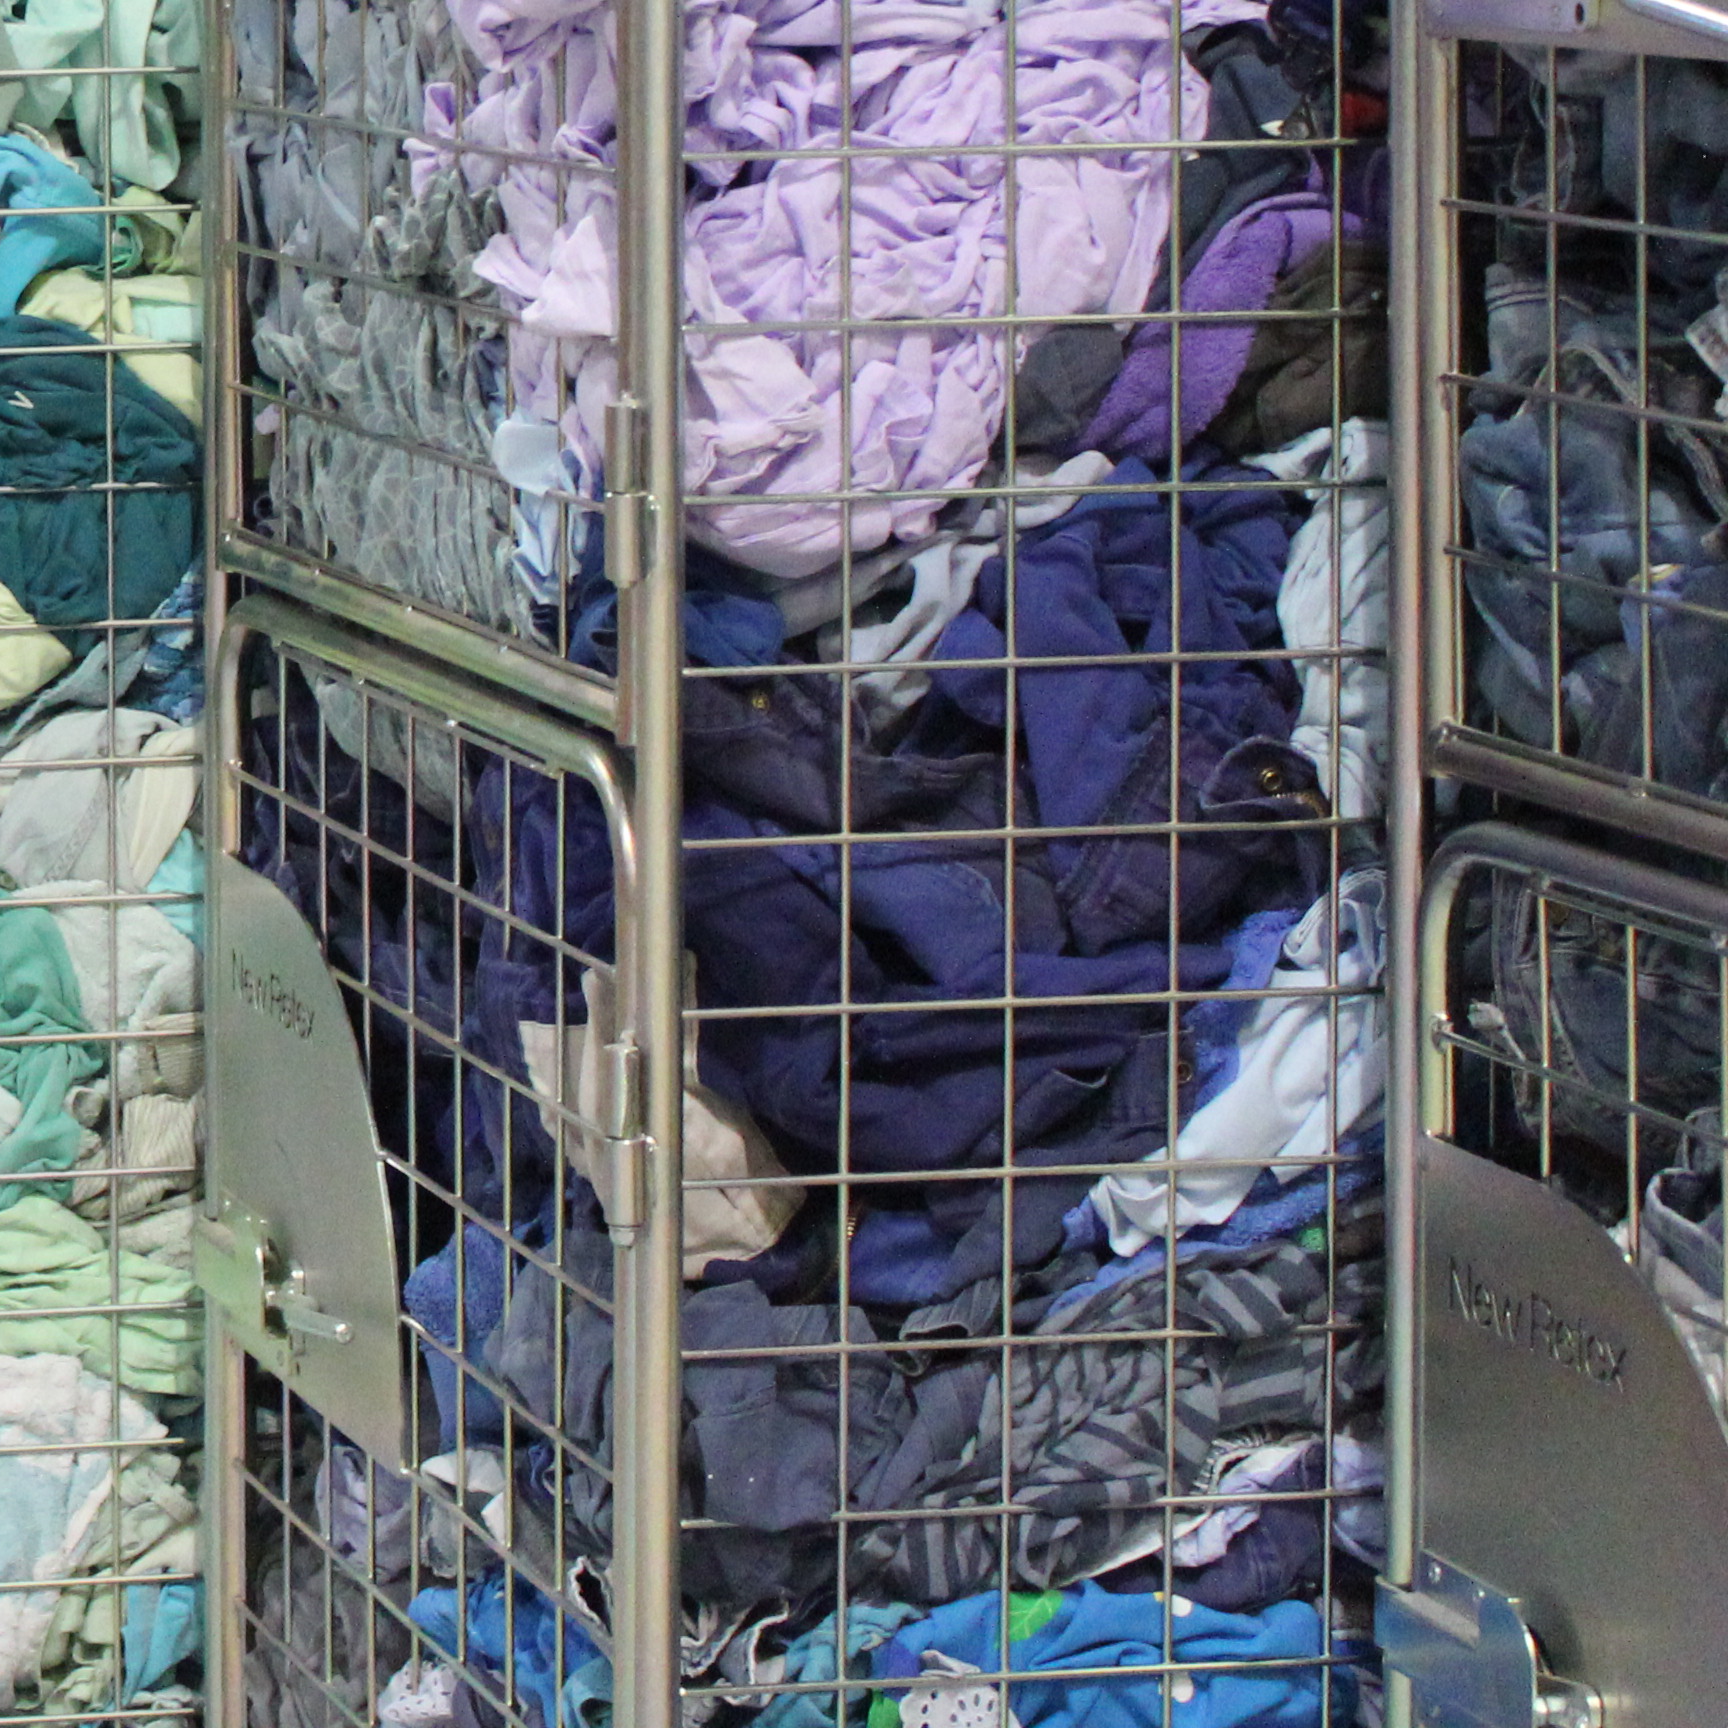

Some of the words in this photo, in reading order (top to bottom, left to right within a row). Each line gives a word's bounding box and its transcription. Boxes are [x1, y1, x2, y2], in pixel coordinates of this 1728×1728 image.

[231, 948, 267, 1014] New
[269, 972, 316, 1044] Retex
[1447, 1256, 1523, 1343] New
[1529, 1290, 1629, 1393] Retex
